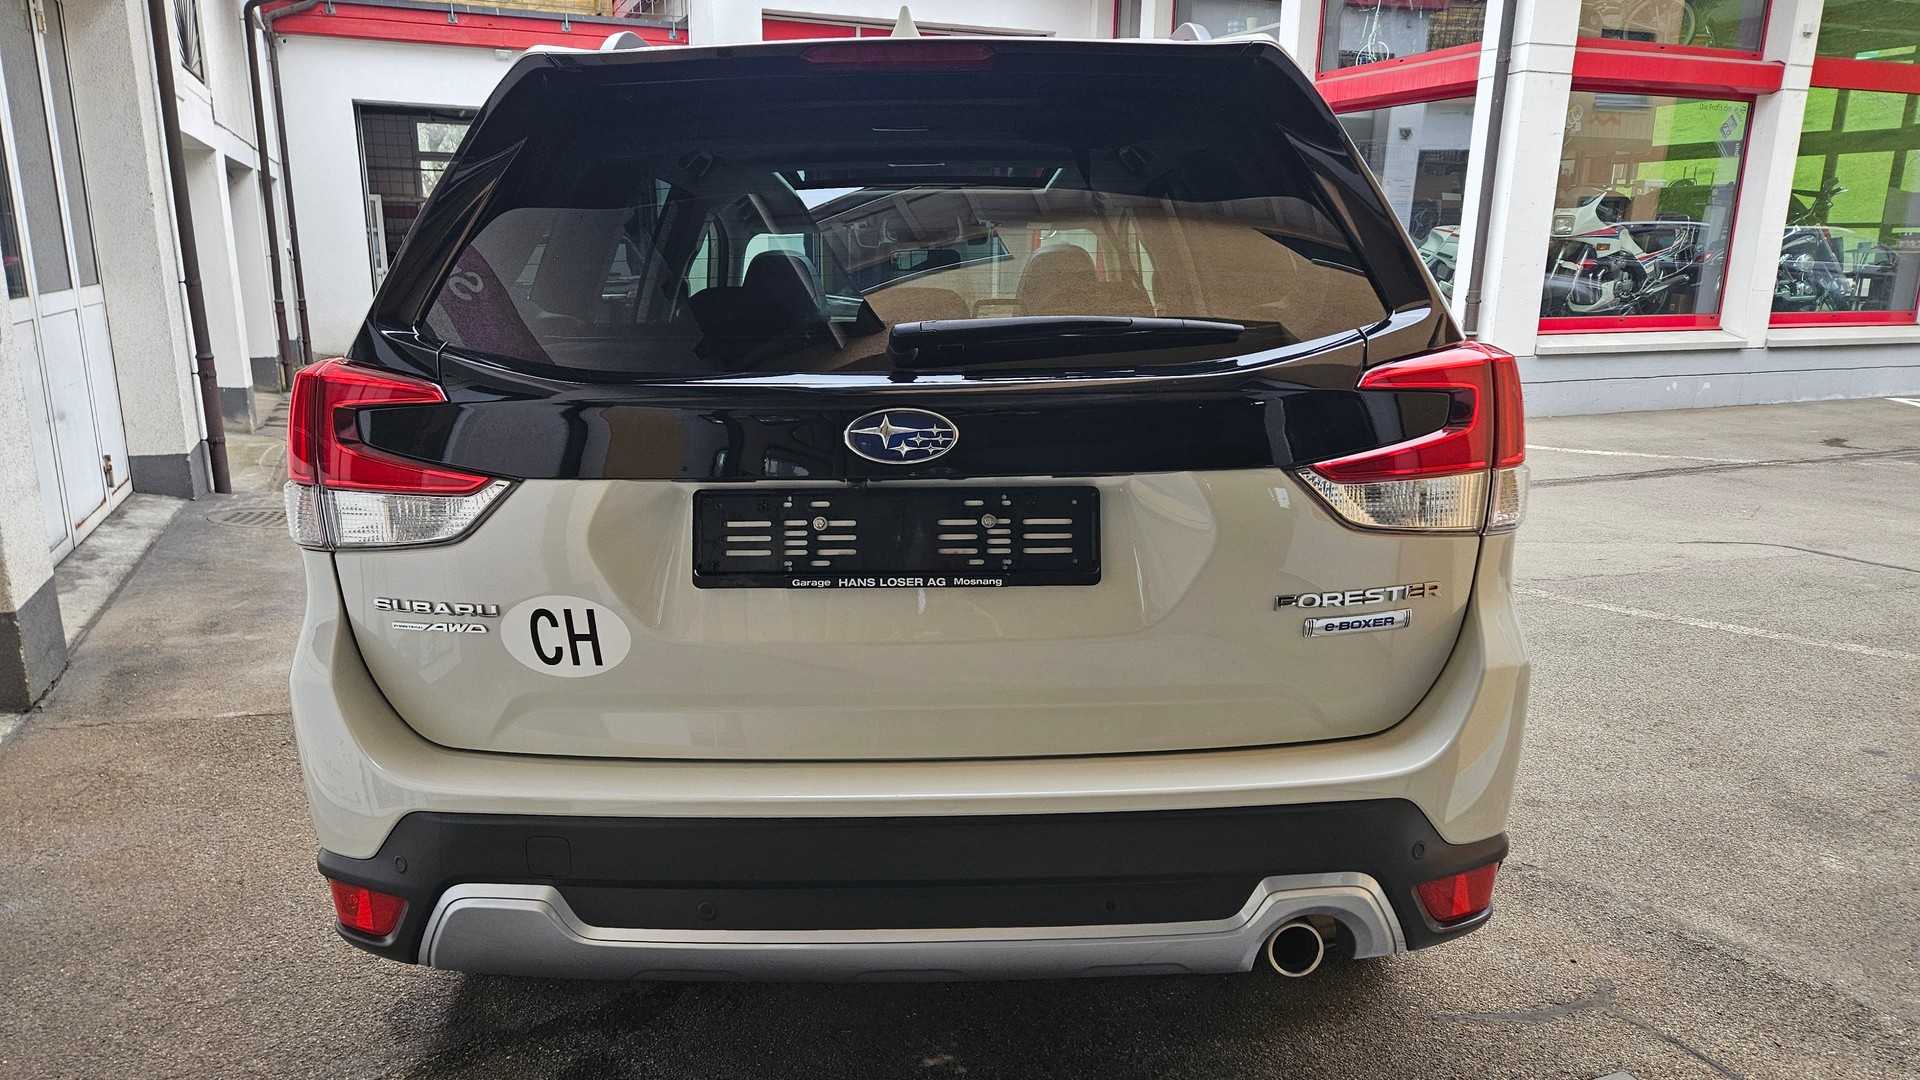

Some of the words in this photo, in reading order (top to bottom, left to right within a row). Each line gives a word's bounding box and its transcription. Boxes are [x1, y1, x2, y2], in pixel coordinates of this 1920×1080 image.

[1709, 103, 1723, 111] Profis
[791, 578, 831, 588] Garage
[838, 578, 876, 587] HANS
[879, 577, 924, 587] LOSER
[927, 577, 946, 587] AG
[953, 576, 1003, 586] Mosnang
[1274, 581, 1443, 611] FORESTER
[373, 597, 500, 618] SUBARU
[425, 621, 489, 634] AWD
[1324, 616, 1395, 632] e-BOXER
[529, 608, 604, 666] CH
